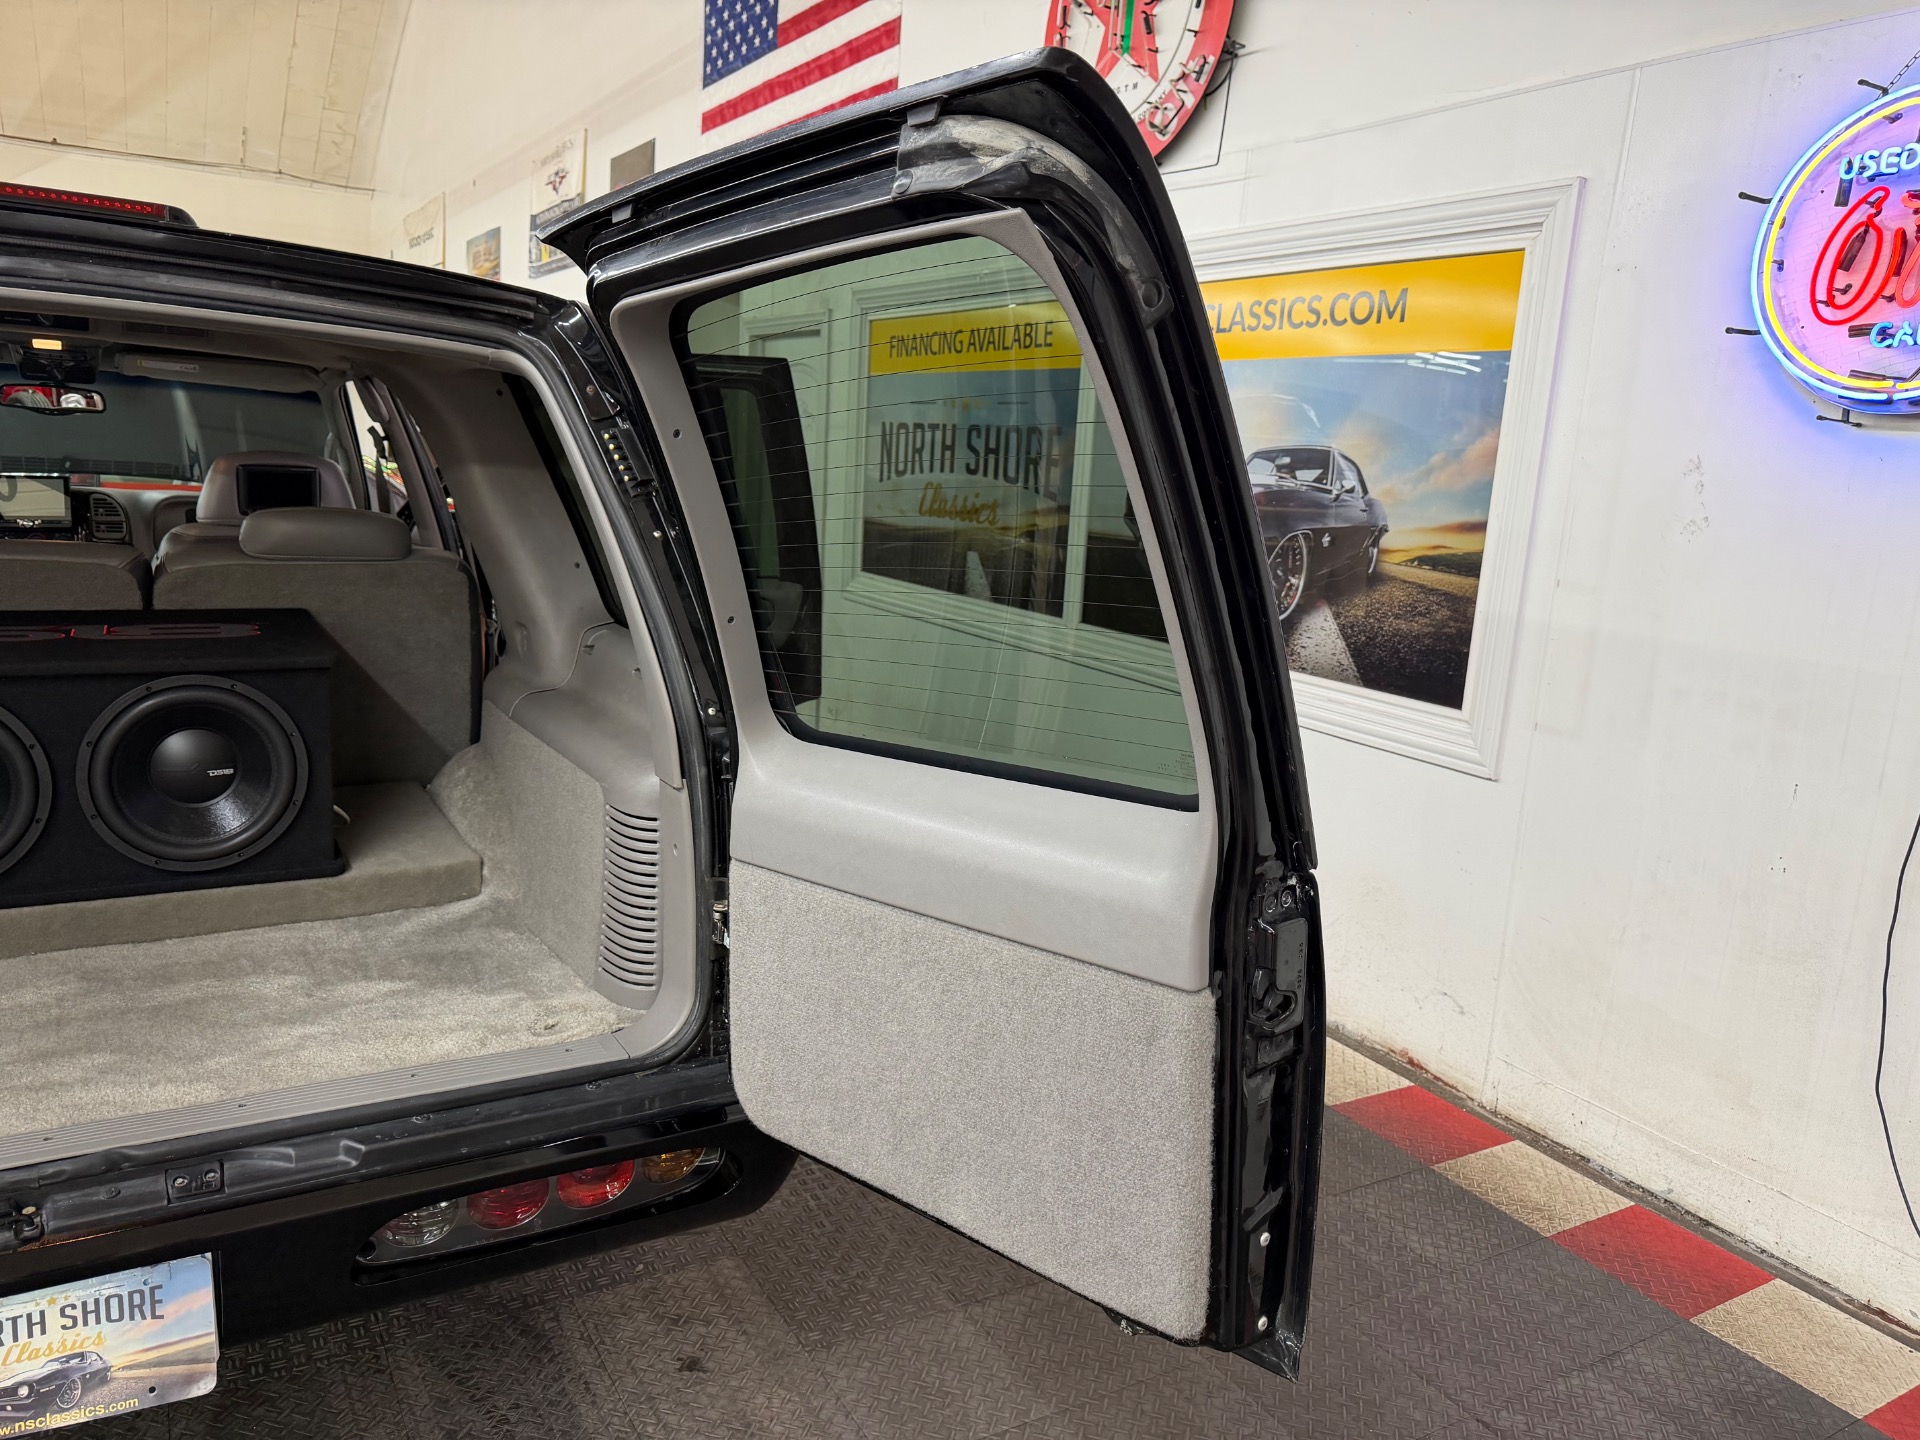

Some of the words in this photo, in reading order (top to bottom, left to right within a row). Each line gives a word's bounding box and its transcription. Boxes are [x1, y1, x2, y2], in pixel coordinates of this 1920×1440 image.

[889, 329, 964, 359] FINANCING
[966, 320, 1054, 353] AVAILABLE
[879, 420, 957, 483] NORTH
[964, 423, 1063, 502] SHORE
[918, 481, 1001, 527] Classics
[0, 1309, 47, 1347] TH
[59, 1284, 165, 1331] SHORE
[1, 1330, 106, 1367] Classics
